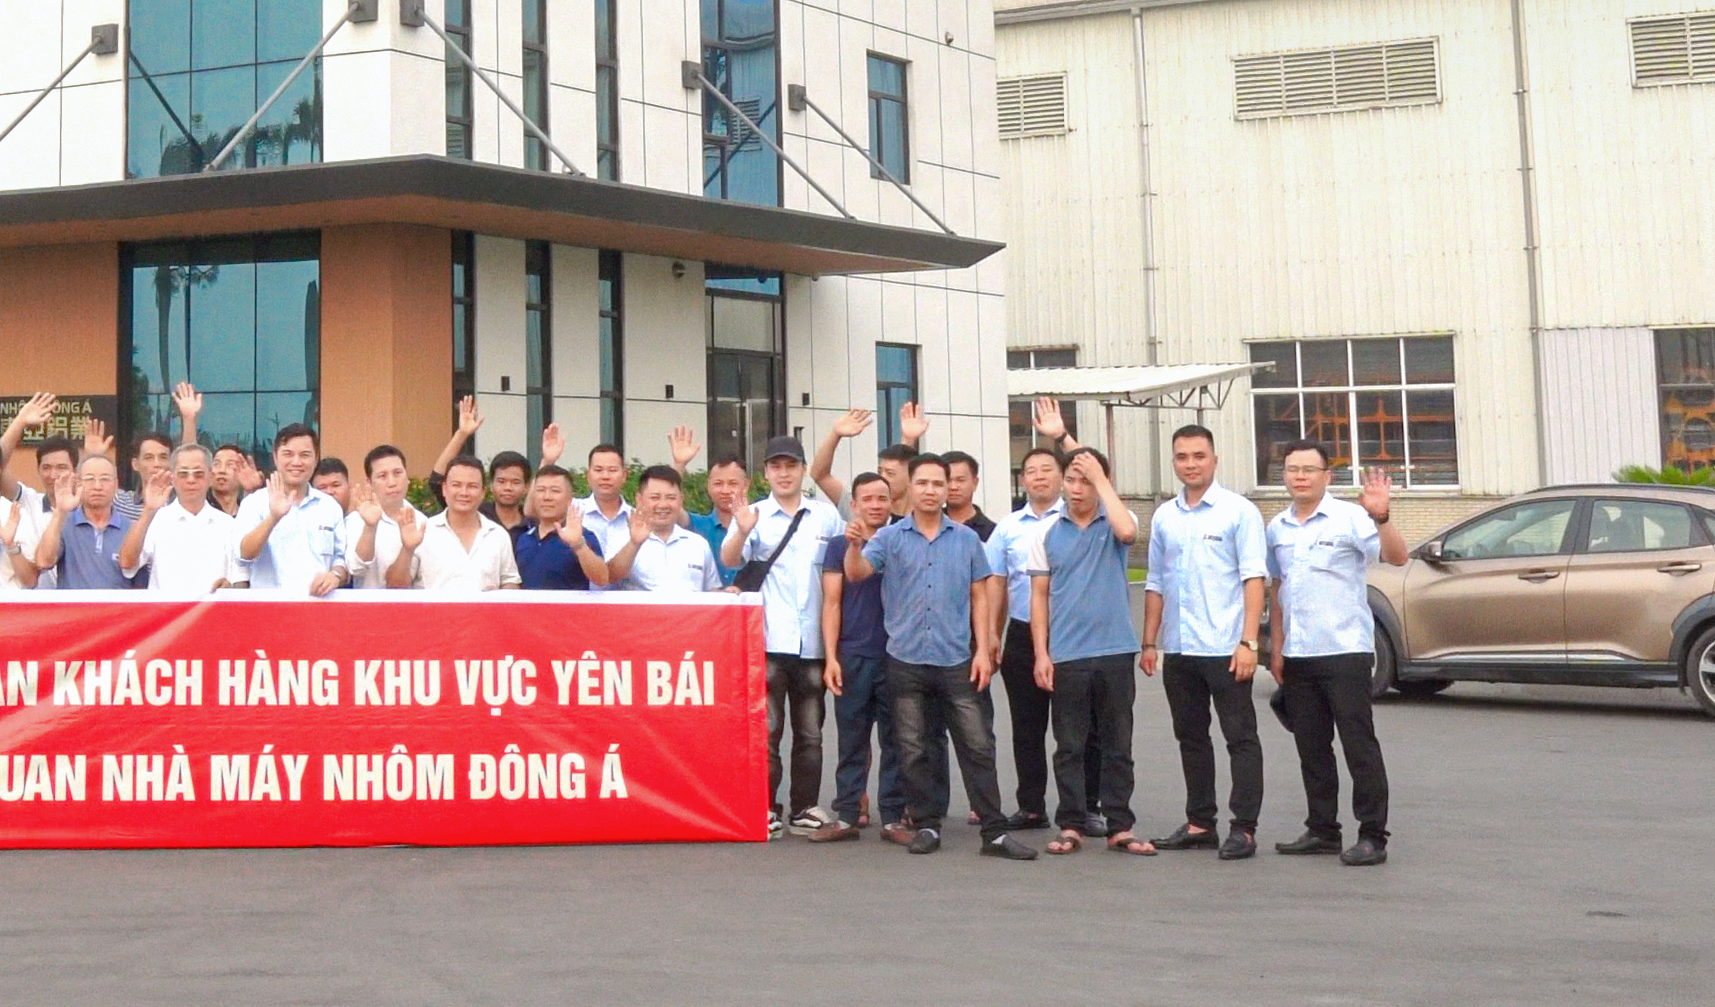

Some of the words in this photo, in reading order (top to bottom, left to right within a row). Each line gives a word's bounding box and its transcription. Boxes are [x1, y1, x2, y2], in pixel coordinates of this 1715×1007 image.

[51, 399, 80, 414] ÔNG
[52, 649, 203, 706] KHÁCH
[218, 649, 339, 706] HÀNG
[354, 659, 441, 706] KHU
[454, 655, 537, 716] VỰC
[551, 650, 633, 706] YÊN
[646, 651, 715, 706] BÁI
[102, 744, 196, 801] NHÀ
[210, 744, 309, 801] MÁY
[323, 744, 454, 801] NHÔM
[468, 743, 586, 800] ĐÔNG
[599, 743, 628, 799] Á
